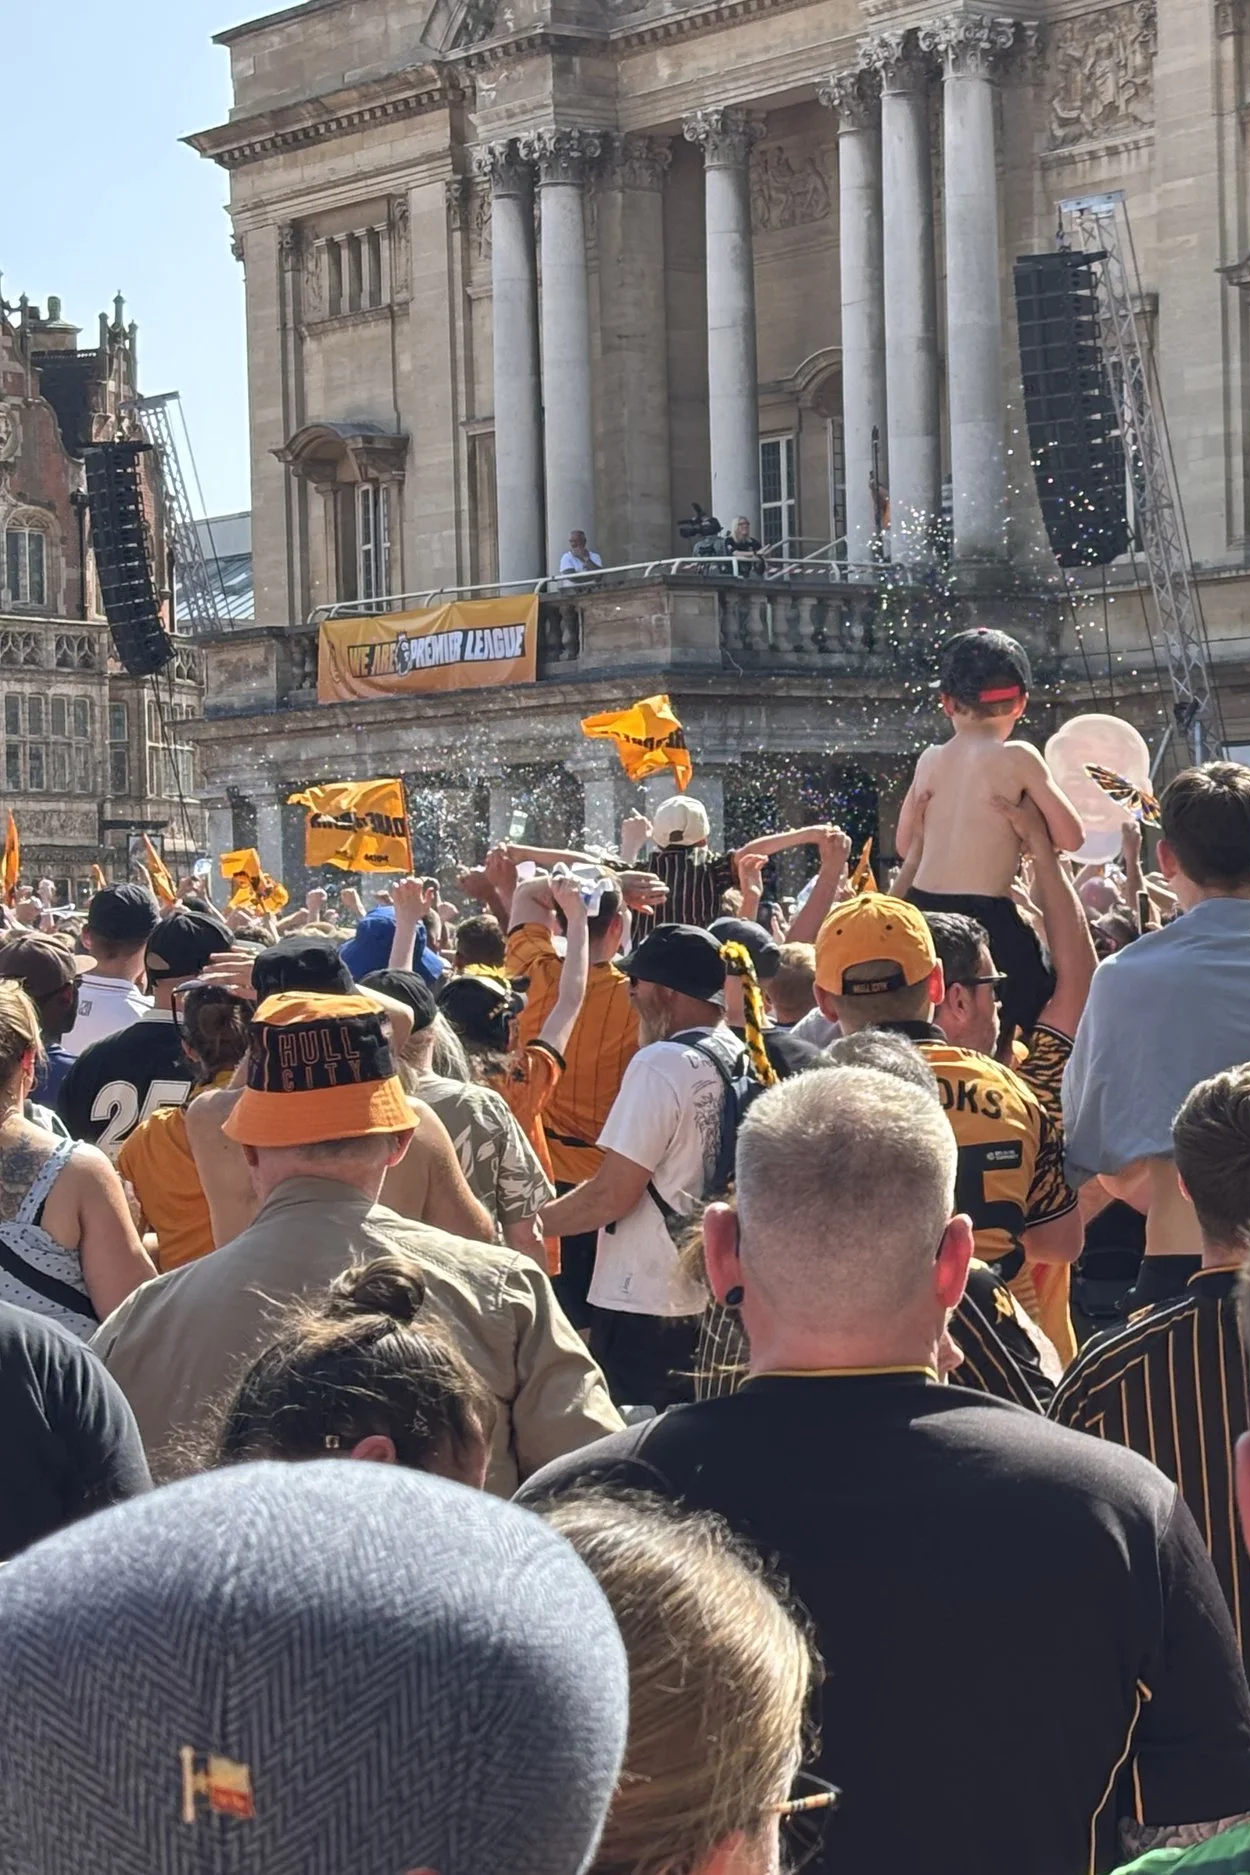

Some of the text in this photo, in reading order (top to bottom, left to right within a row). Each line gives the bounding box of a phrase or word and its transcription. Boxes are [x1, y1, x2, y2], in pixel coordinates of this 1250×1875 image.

[349, 625, 525, 677] WE ARE PREMIER LEAGUE
[278, 1027, 360, 1068] HULL
[281, 1059, 362, 1092] CITY
